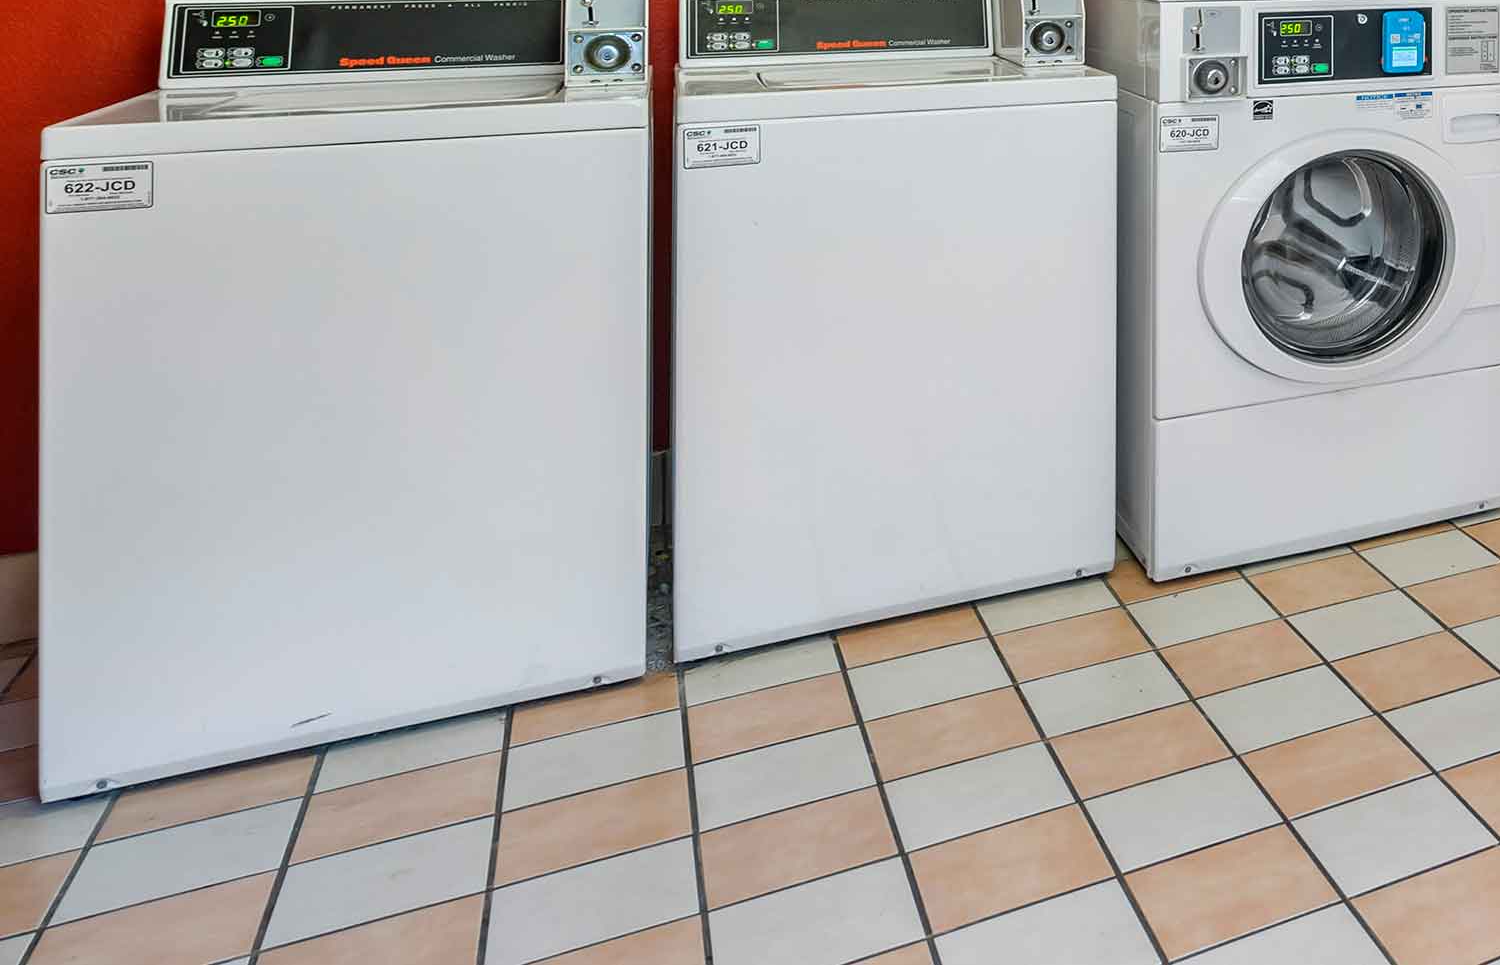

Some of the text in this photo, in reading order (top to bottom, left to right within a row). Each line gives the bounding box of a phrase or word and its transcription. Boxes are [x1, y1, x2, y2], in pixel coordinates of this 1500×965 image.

[718, 4, 744, 14] 250
[216, 15, 249, 27] 250
[1281, 23, 1301, 34] 250
[434, 54, 483, 64] Commercial
[485, 53, 516, 62] Washer
[1170, 128, 1209, 138] 620-JCD
[697, 140, 748, 152] 621-JCD
[49, 167, 77, 176] CSC
[64, 180, 136, 194] 622-JCD
